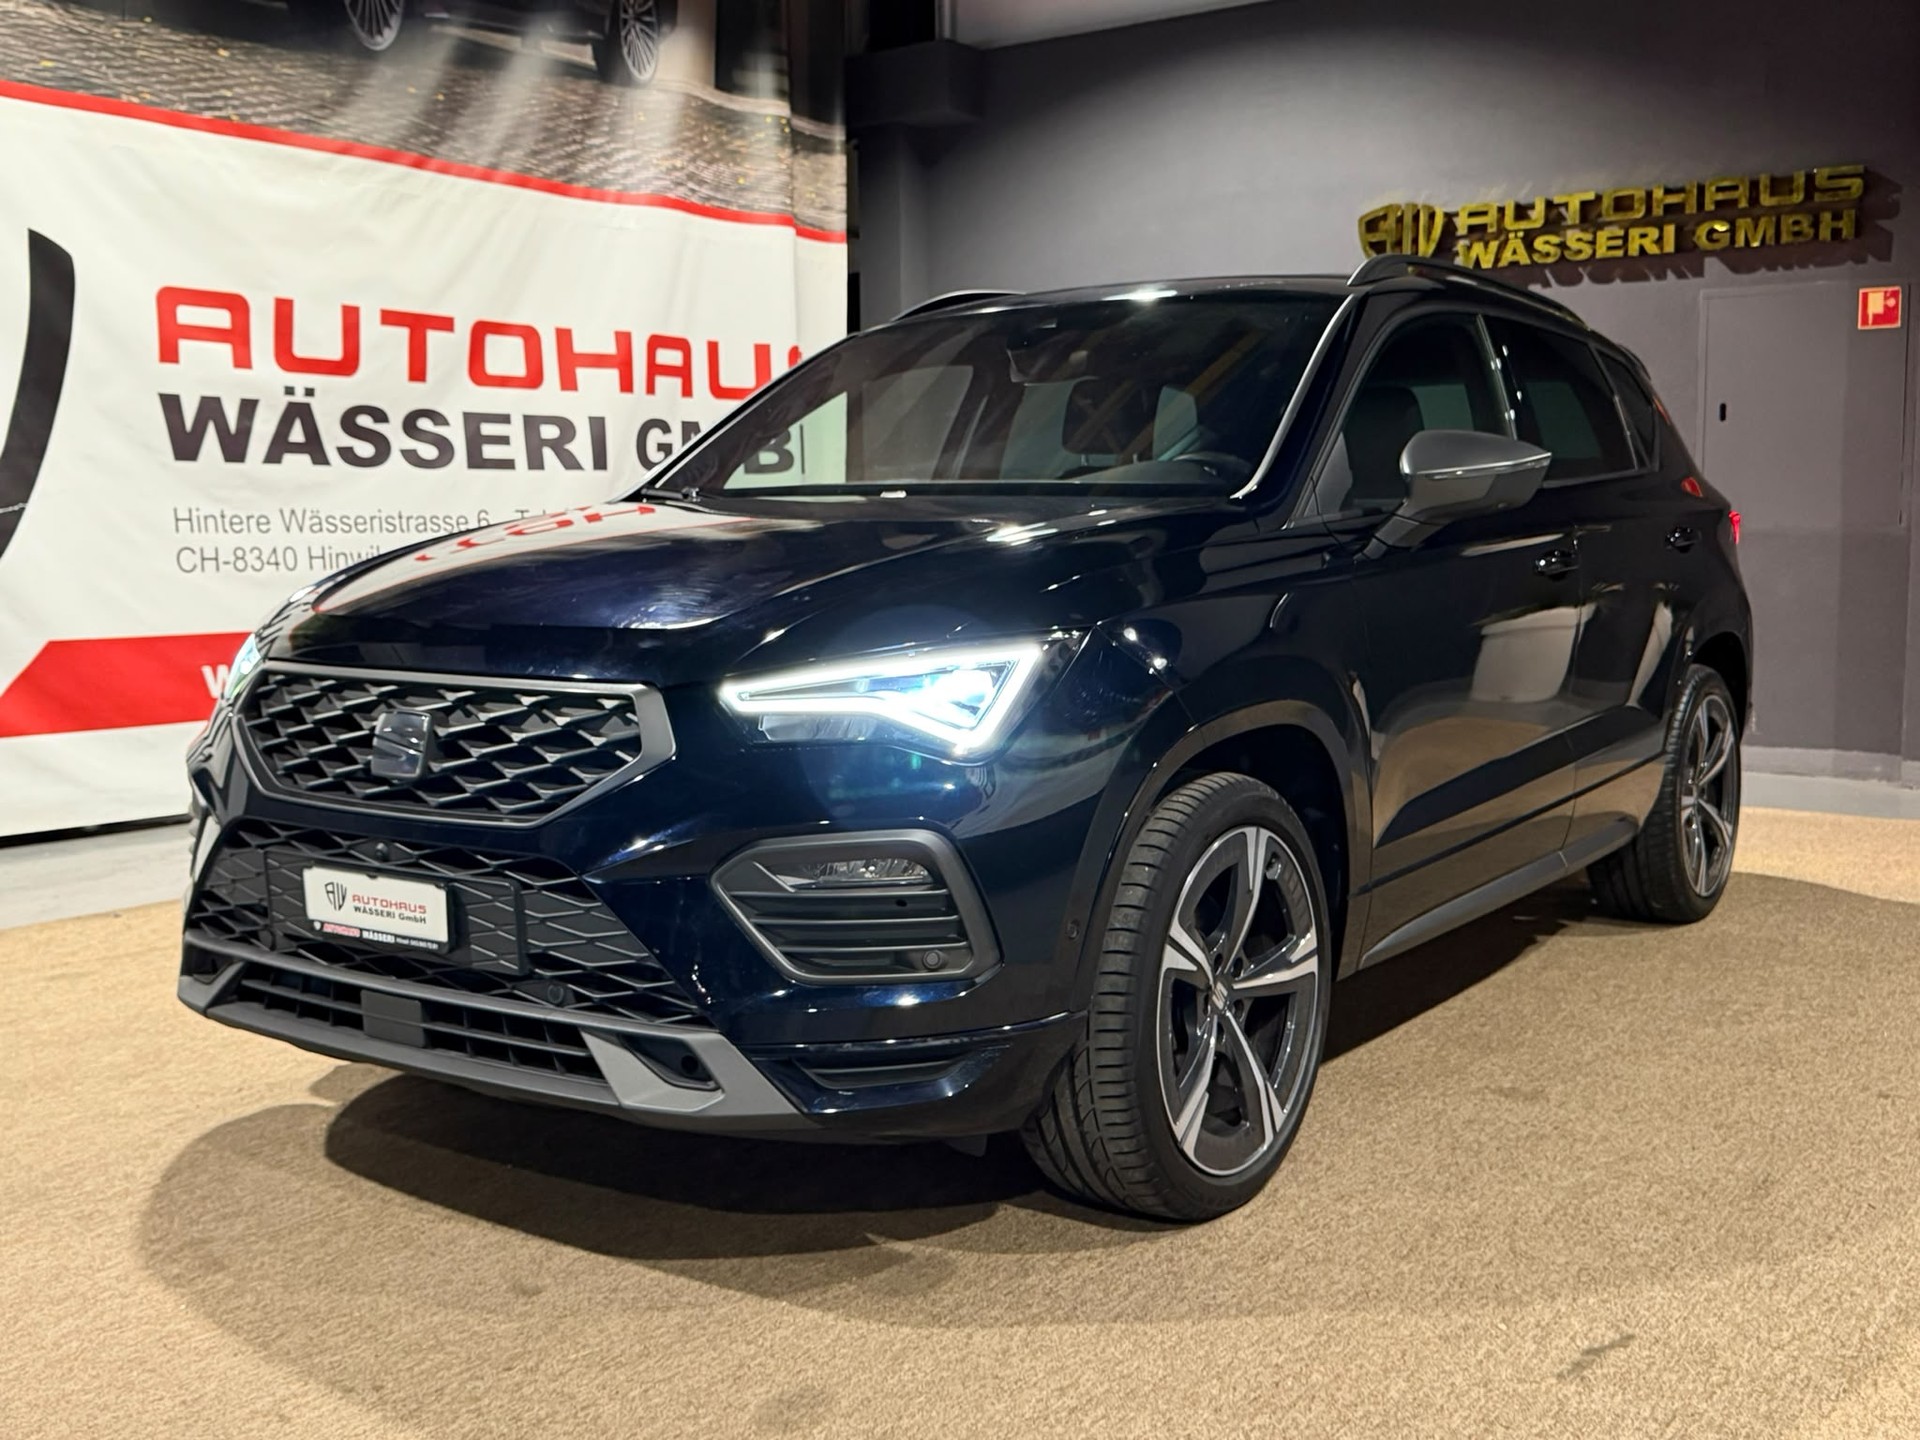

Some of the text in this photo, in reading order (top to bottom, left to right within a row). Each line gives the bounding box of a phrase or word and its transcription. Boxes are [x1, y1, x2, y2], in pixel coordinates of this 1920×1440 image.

[1456, 164, 1866, 236] AUTOHAUS
[1457, 208, 1856, 270] WÄSSERI GMBH
[156, 286, 802, 401] AUTOHAU
[158, 386, 608, 470] WÄSSERI
[173, 507, 271, 534] Hintere
[279, 508, 469, 535] Wässeristrasse
[176, 546, 298, 574] CH-8340
[352, 894, 427, 914] AUTOHAUS
[398, 913, 427, 924] GmbH
